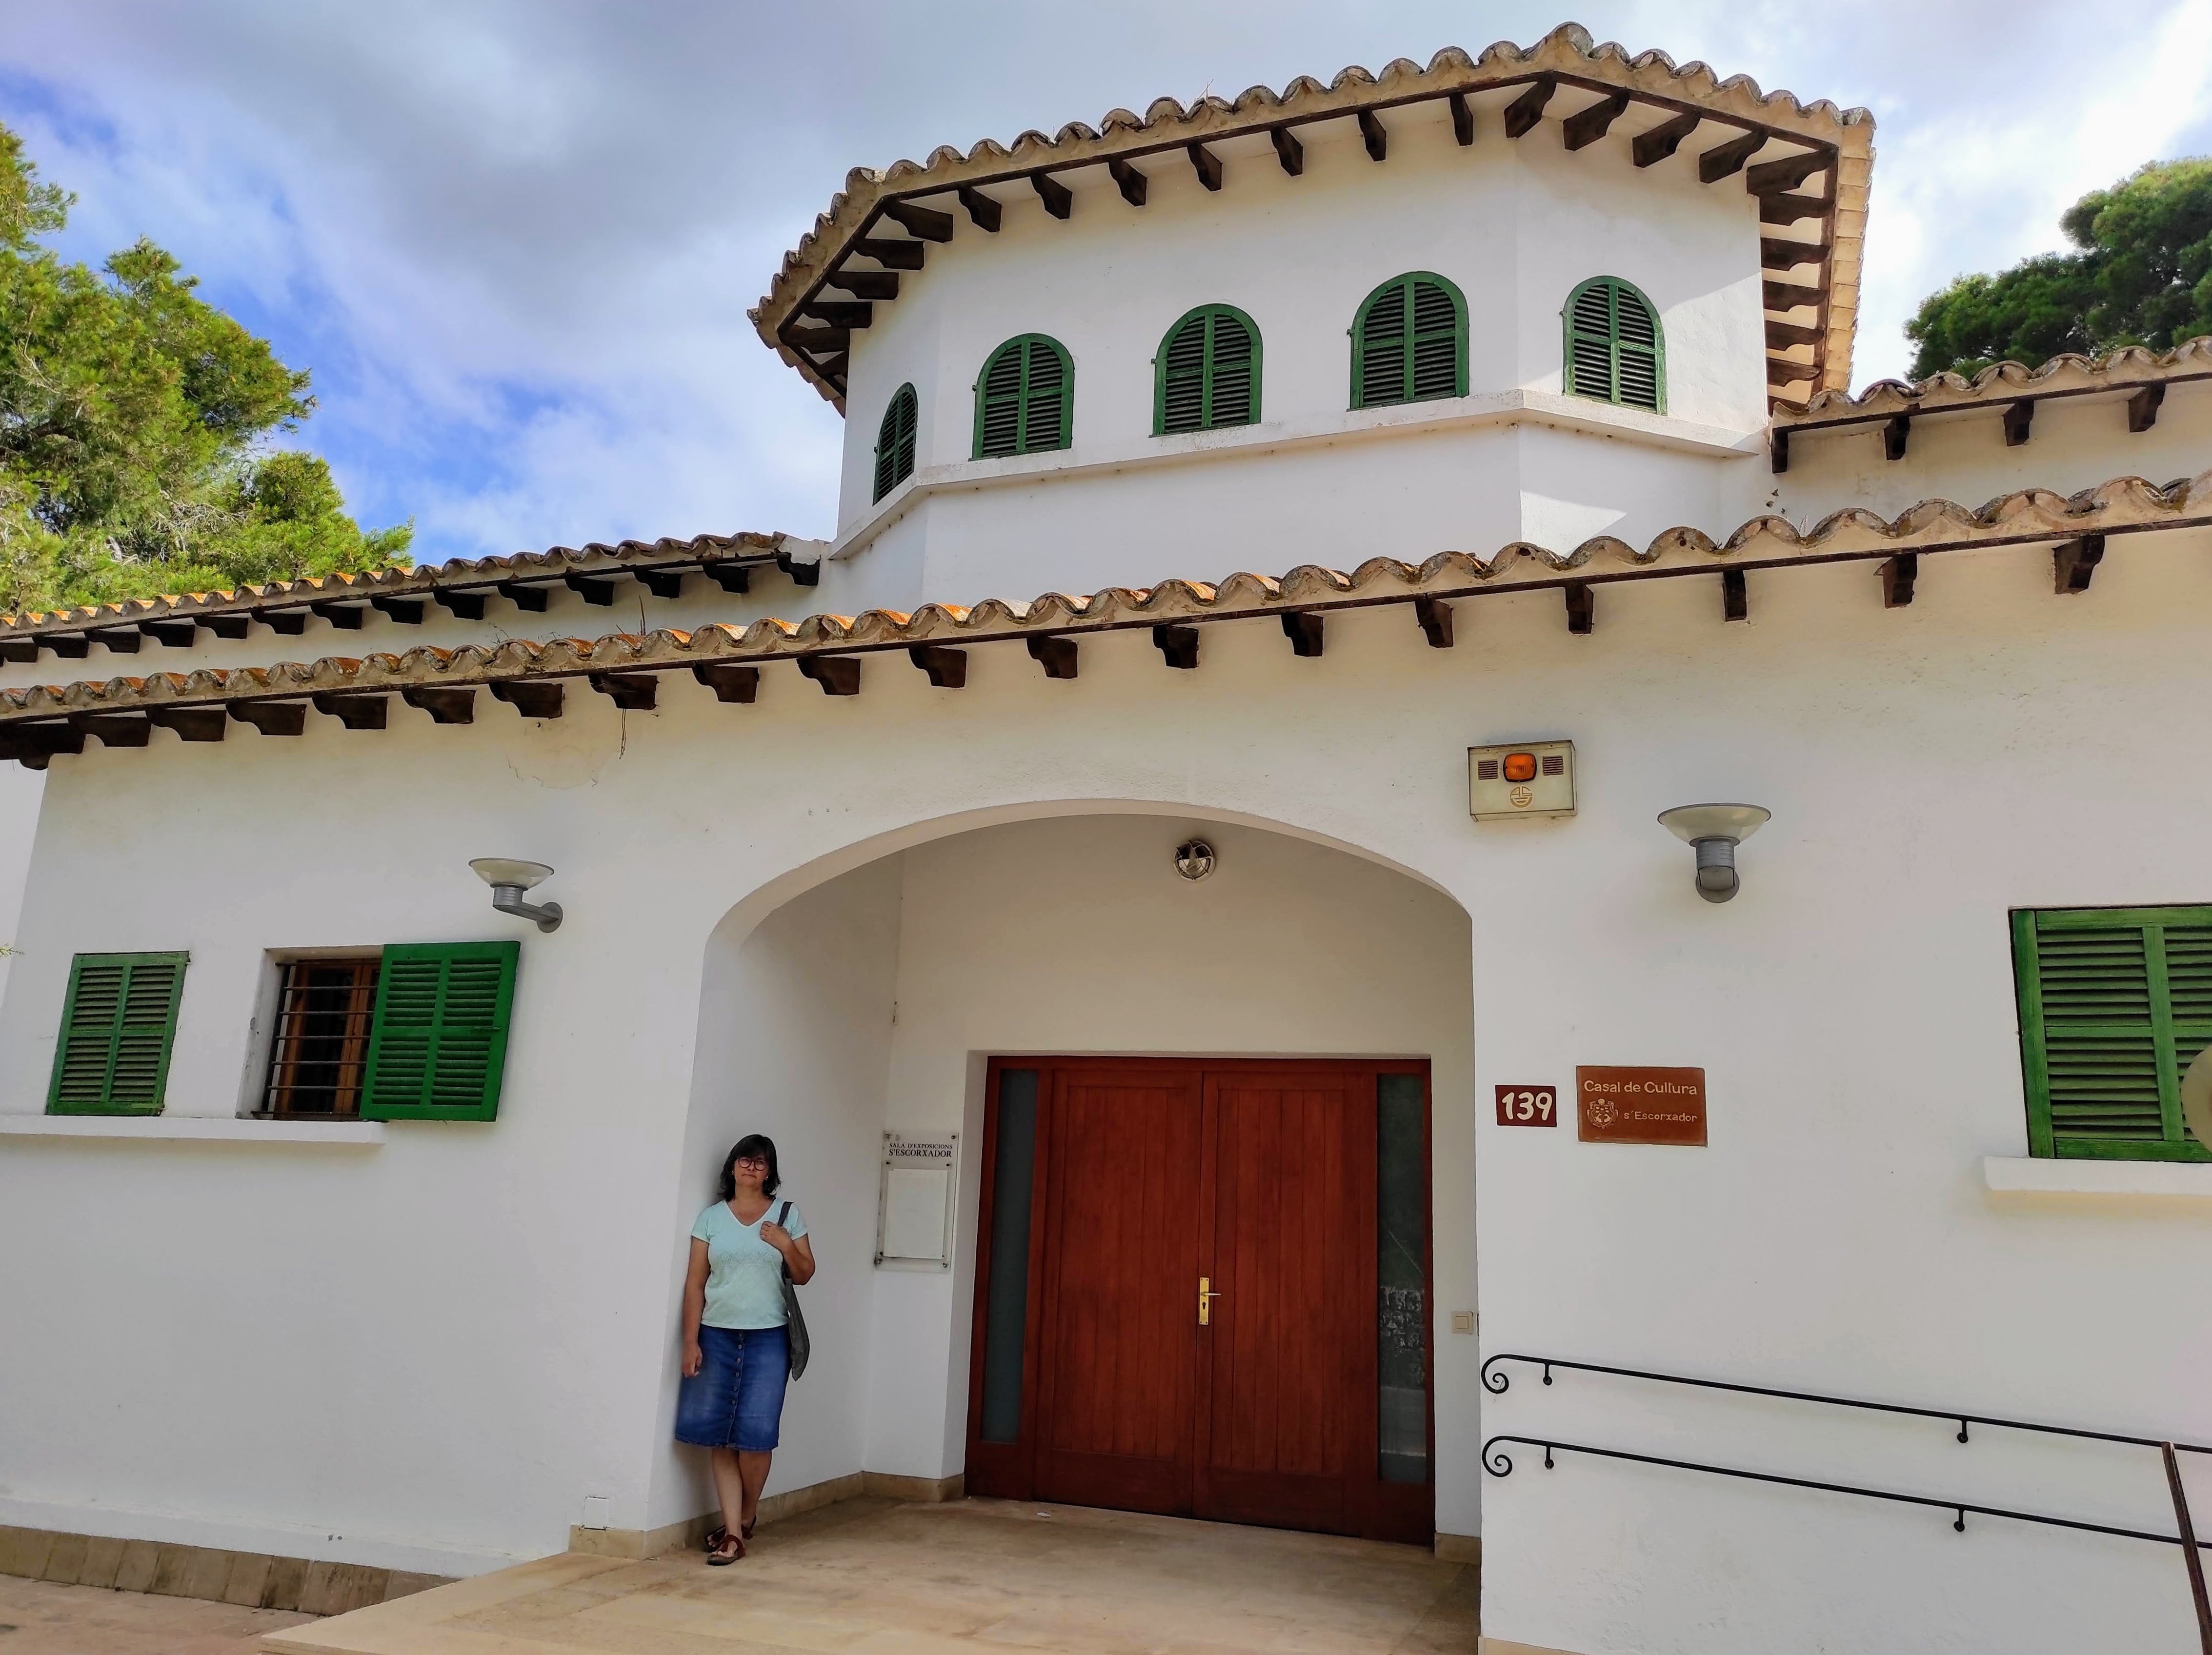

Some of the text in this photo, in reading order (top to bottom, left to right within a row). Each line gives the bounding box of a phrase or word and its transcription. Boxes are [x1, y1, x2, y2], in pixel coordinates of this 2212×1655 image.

[1584, 1080, 1698, 1095] Casal de Cultura
[1501, 1092, 1553, 1121] 139
[888, 1149, 952, 1157] S'ESCORXADOR
